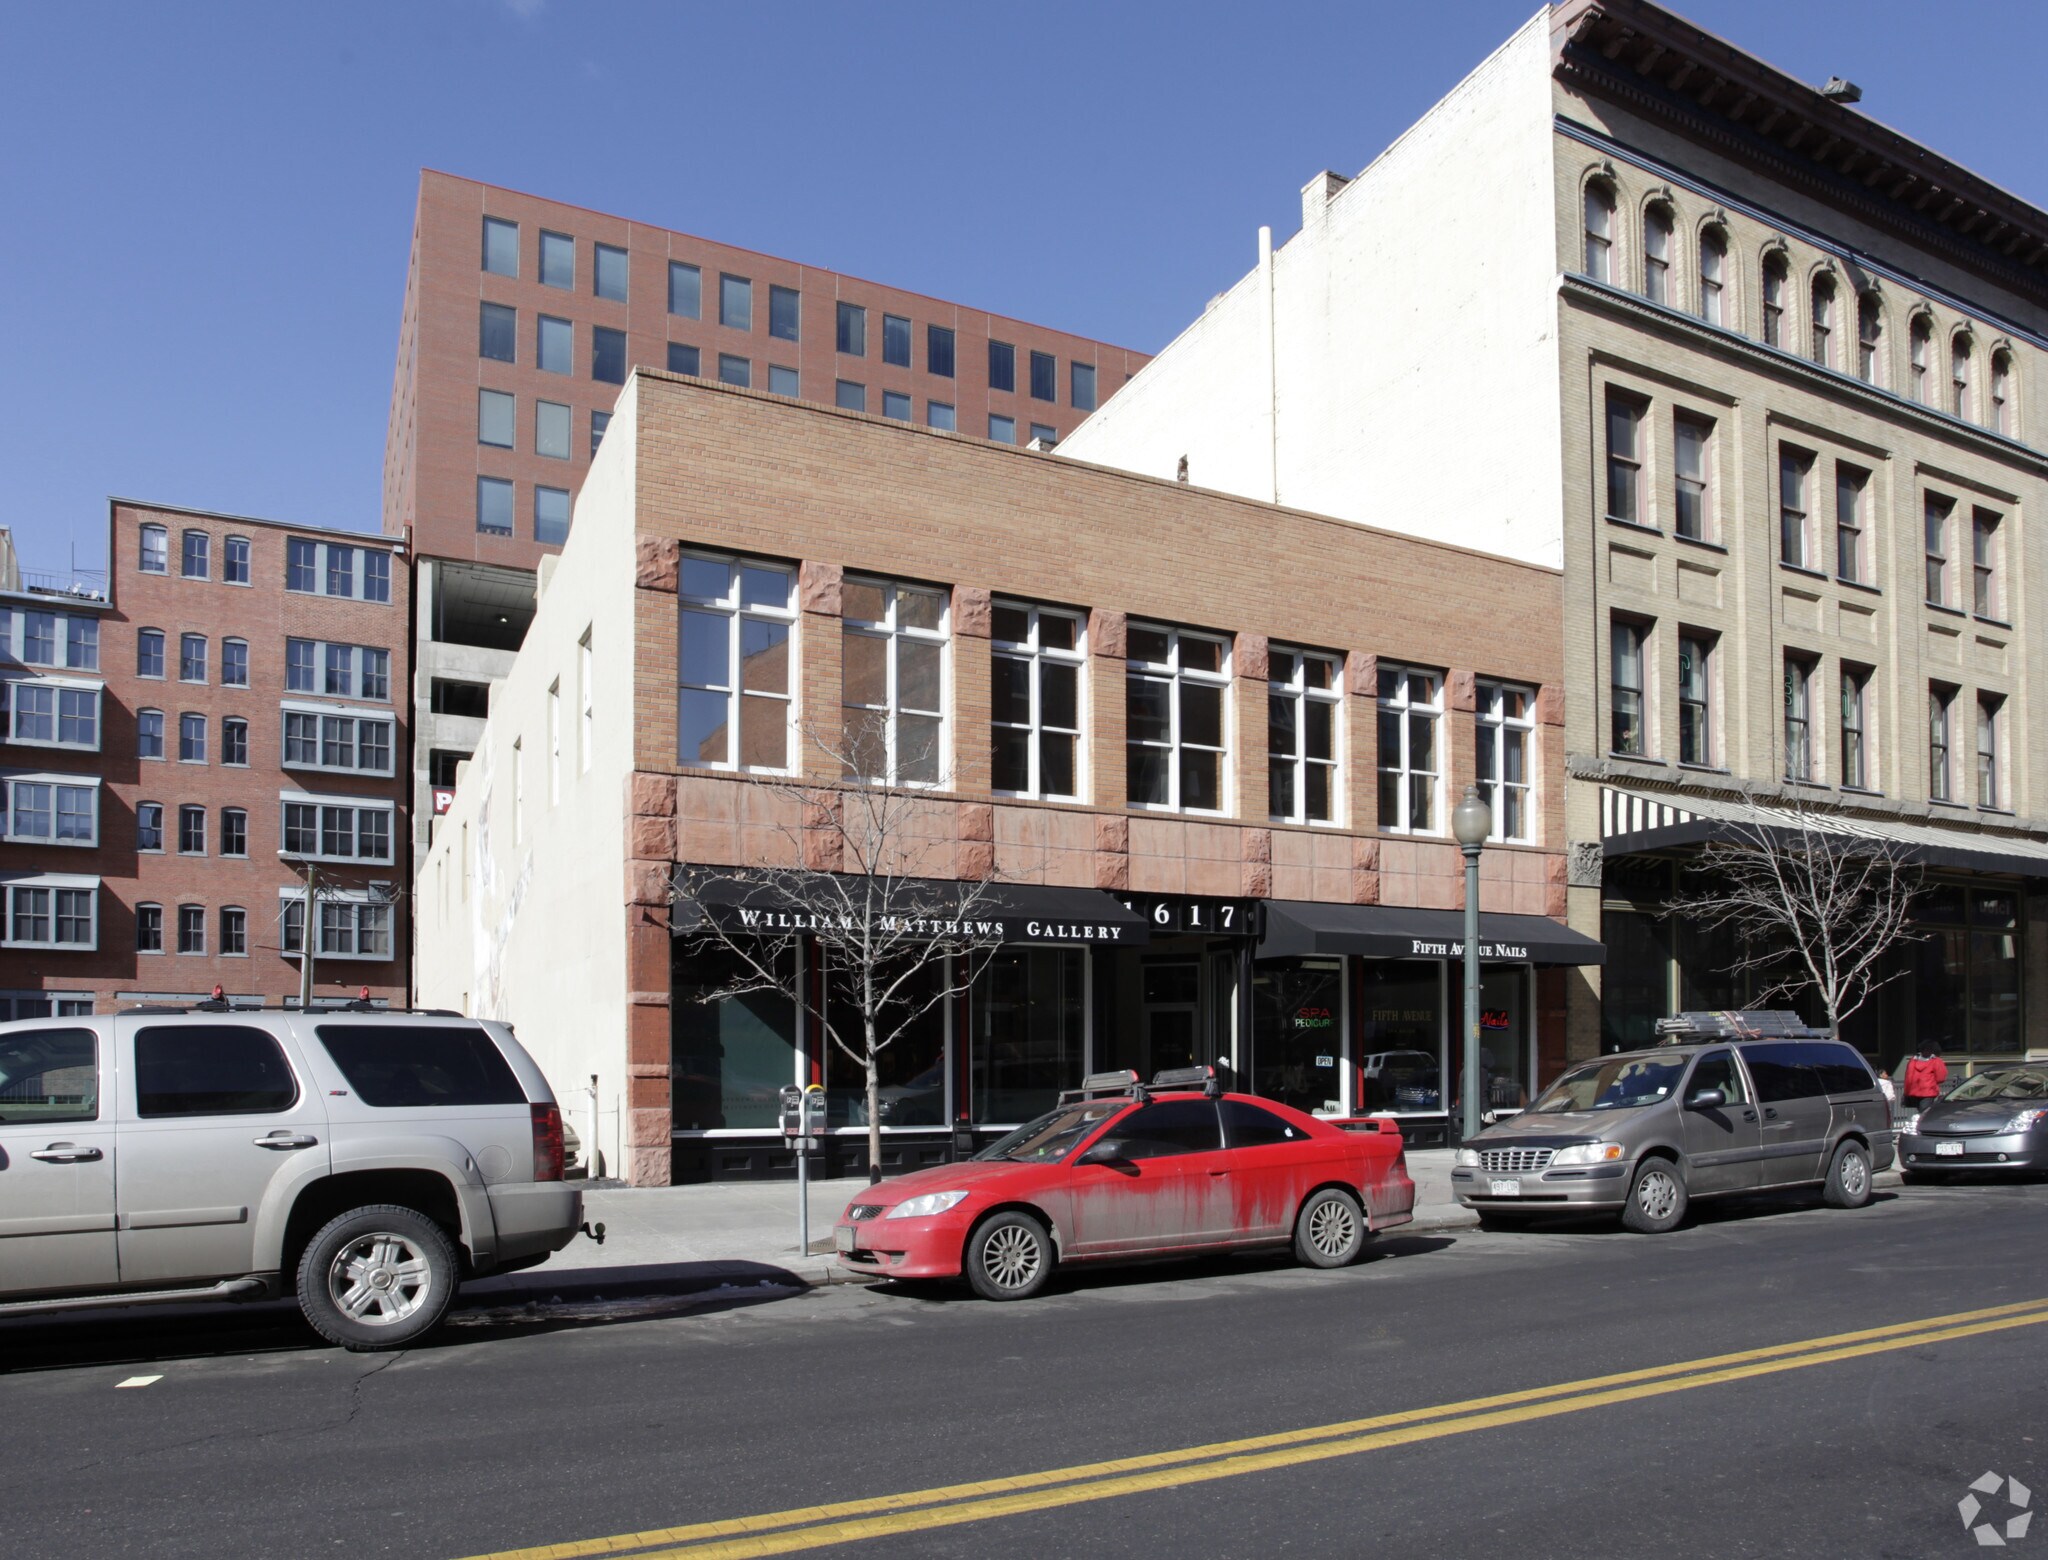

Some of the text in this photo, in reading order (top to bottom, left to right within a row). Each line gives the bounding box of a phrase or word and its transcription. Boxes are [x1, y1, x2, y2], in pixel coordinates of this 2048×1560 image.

[739, 910, 1121, 940] WILLIAM MATTHEWS GALLERY
[1412, 940, 1527, 958] FIFTH AVUE NAILS
[1317, 1057, 1332, 1066] OPEN
